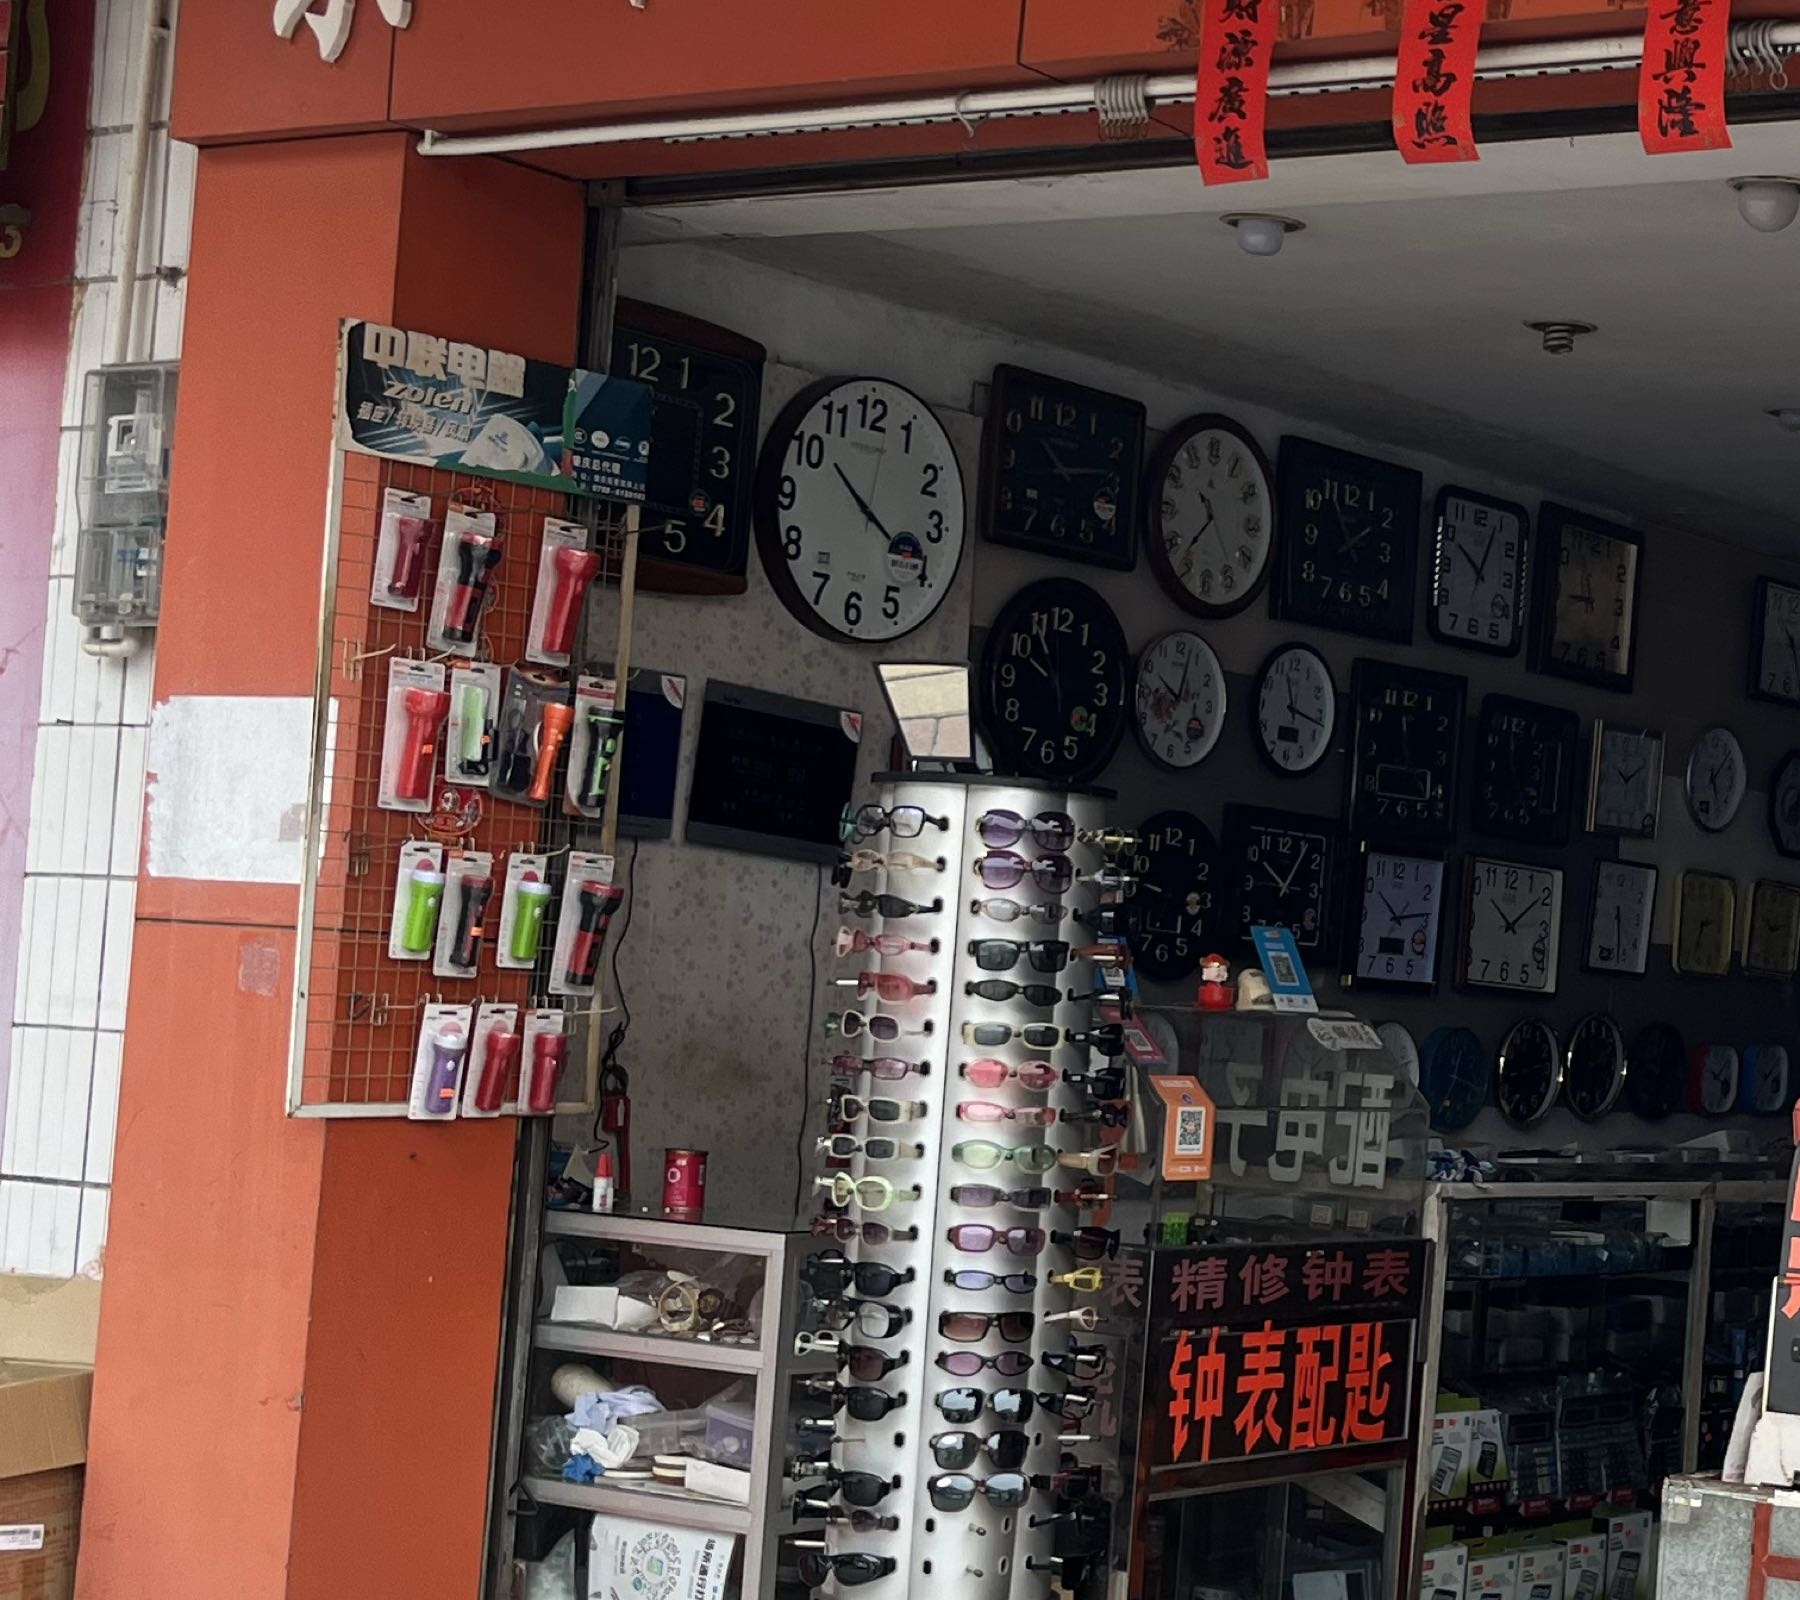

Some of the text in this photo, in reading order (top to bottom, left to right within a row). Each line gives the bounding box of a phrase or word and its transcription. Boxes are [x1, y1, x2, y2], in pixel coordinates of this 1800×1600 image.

[628, 343, 661, 383] 12
[680, 356, 690, 389] 1
[712, 393, 736, 428] 2
[823, 401, 848, 437] 11
[857, 394, 888, 432] 12
[793, 431, 824, 469] 10
[901, 421, 912, 453] 1
[710, 446, 731, 480] 3
[777, 475, 797, 510] 9
[921, 464, 939, 497] 2
[663, 520, 687, 553] 5
[703, 503, 725, 537] 4
[927, 510, 944, 543] 3
[785, 525, 801, 560] 8
[812, 572, 830, 605] 7
[883, 586, 900, 619] 5
[844, 592, 862, 626] 6
[1031, 611, 1048, 636] 11
[1052, 607, 1074, 633] 12
[1011, 632, 1031, 658] 10
[1080, 623, 1088, 646] 1
[1001, 663, 1016, 688] 9
[1090, 650, 1106, 675] 2
[1005, 698, 1020, 722] 8
[1093, 683, 1108, 706] 3
[1021, 727, 1037, 752] 7
[1040, 739, 1055, 764] 6
[1064, 736, 1078, 760] 5
[1171, 1249, 1411, 1312] 精修钟表
[1169, 1320, 1392, 1463] 钟表配匙
